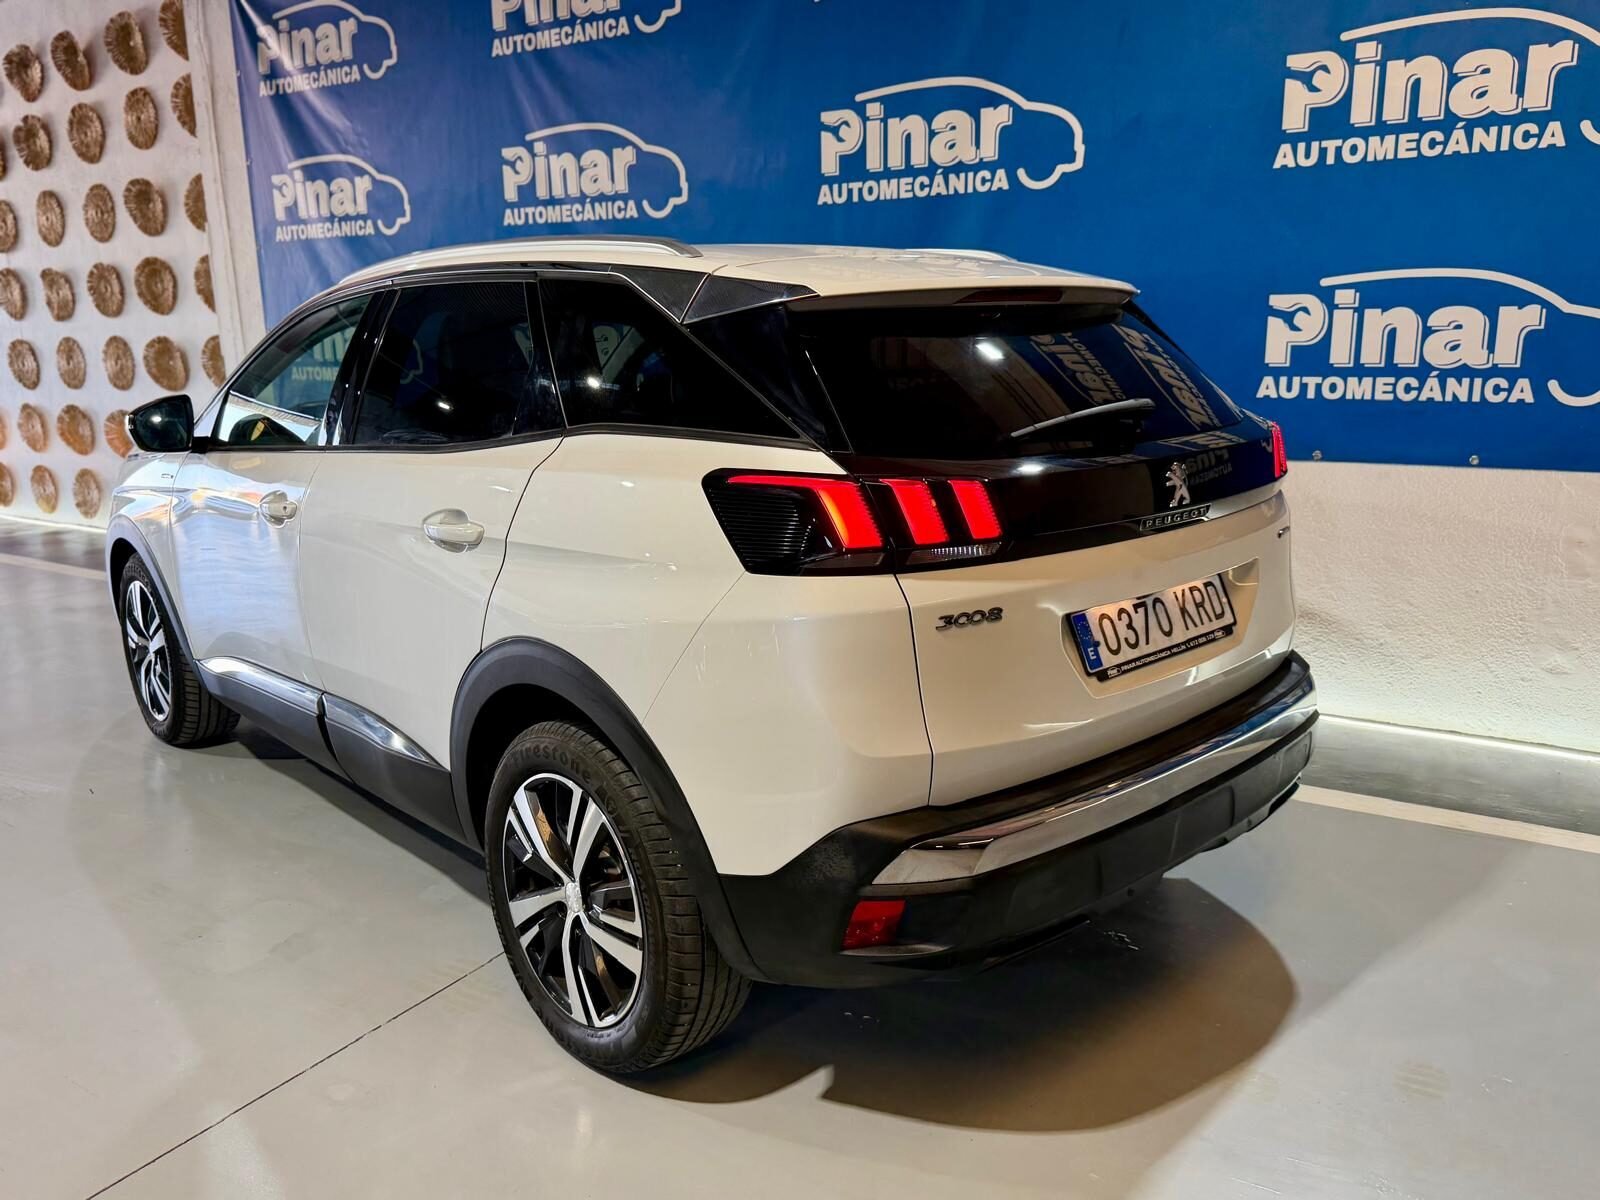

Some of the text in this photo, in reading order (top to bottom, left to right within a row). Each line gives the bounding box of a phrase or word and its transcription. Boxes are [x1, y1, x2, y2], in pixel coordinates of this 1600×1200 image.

[257, 18, 358, 75] Pinar
[491, 16, 630, 57] AUTOMECÁNICA
[259, 65, 361, 97] AUTOMECÁNICA
[1281, 39, 1579, 133] Pinar
[820, 102, 1012, 176] Pinar
[1272, 121, 1566, 169] AUTOMECÁNICA
[501, 141, 636, 202] Pinar
[817, 169, 1009, 205] AUTOMECÁNICA
[271, 170, 372, 221] Pinar
[503, 198, 638, 226] AUTOMECÁNICA
[275, 218, 375, 242] AUTOMECÁNICA
[1264, 289, 1546, 368] Pinar
[1256, 371, 1535, 403] AUTOMECÁNICA
[1145, 507, 1207, 528] PEUGEOT
[936, 606, 1003, 630] 3008
[1098, 581, 1226, 656] 0370 KRD
[1088, 647, 1097, 660] E
